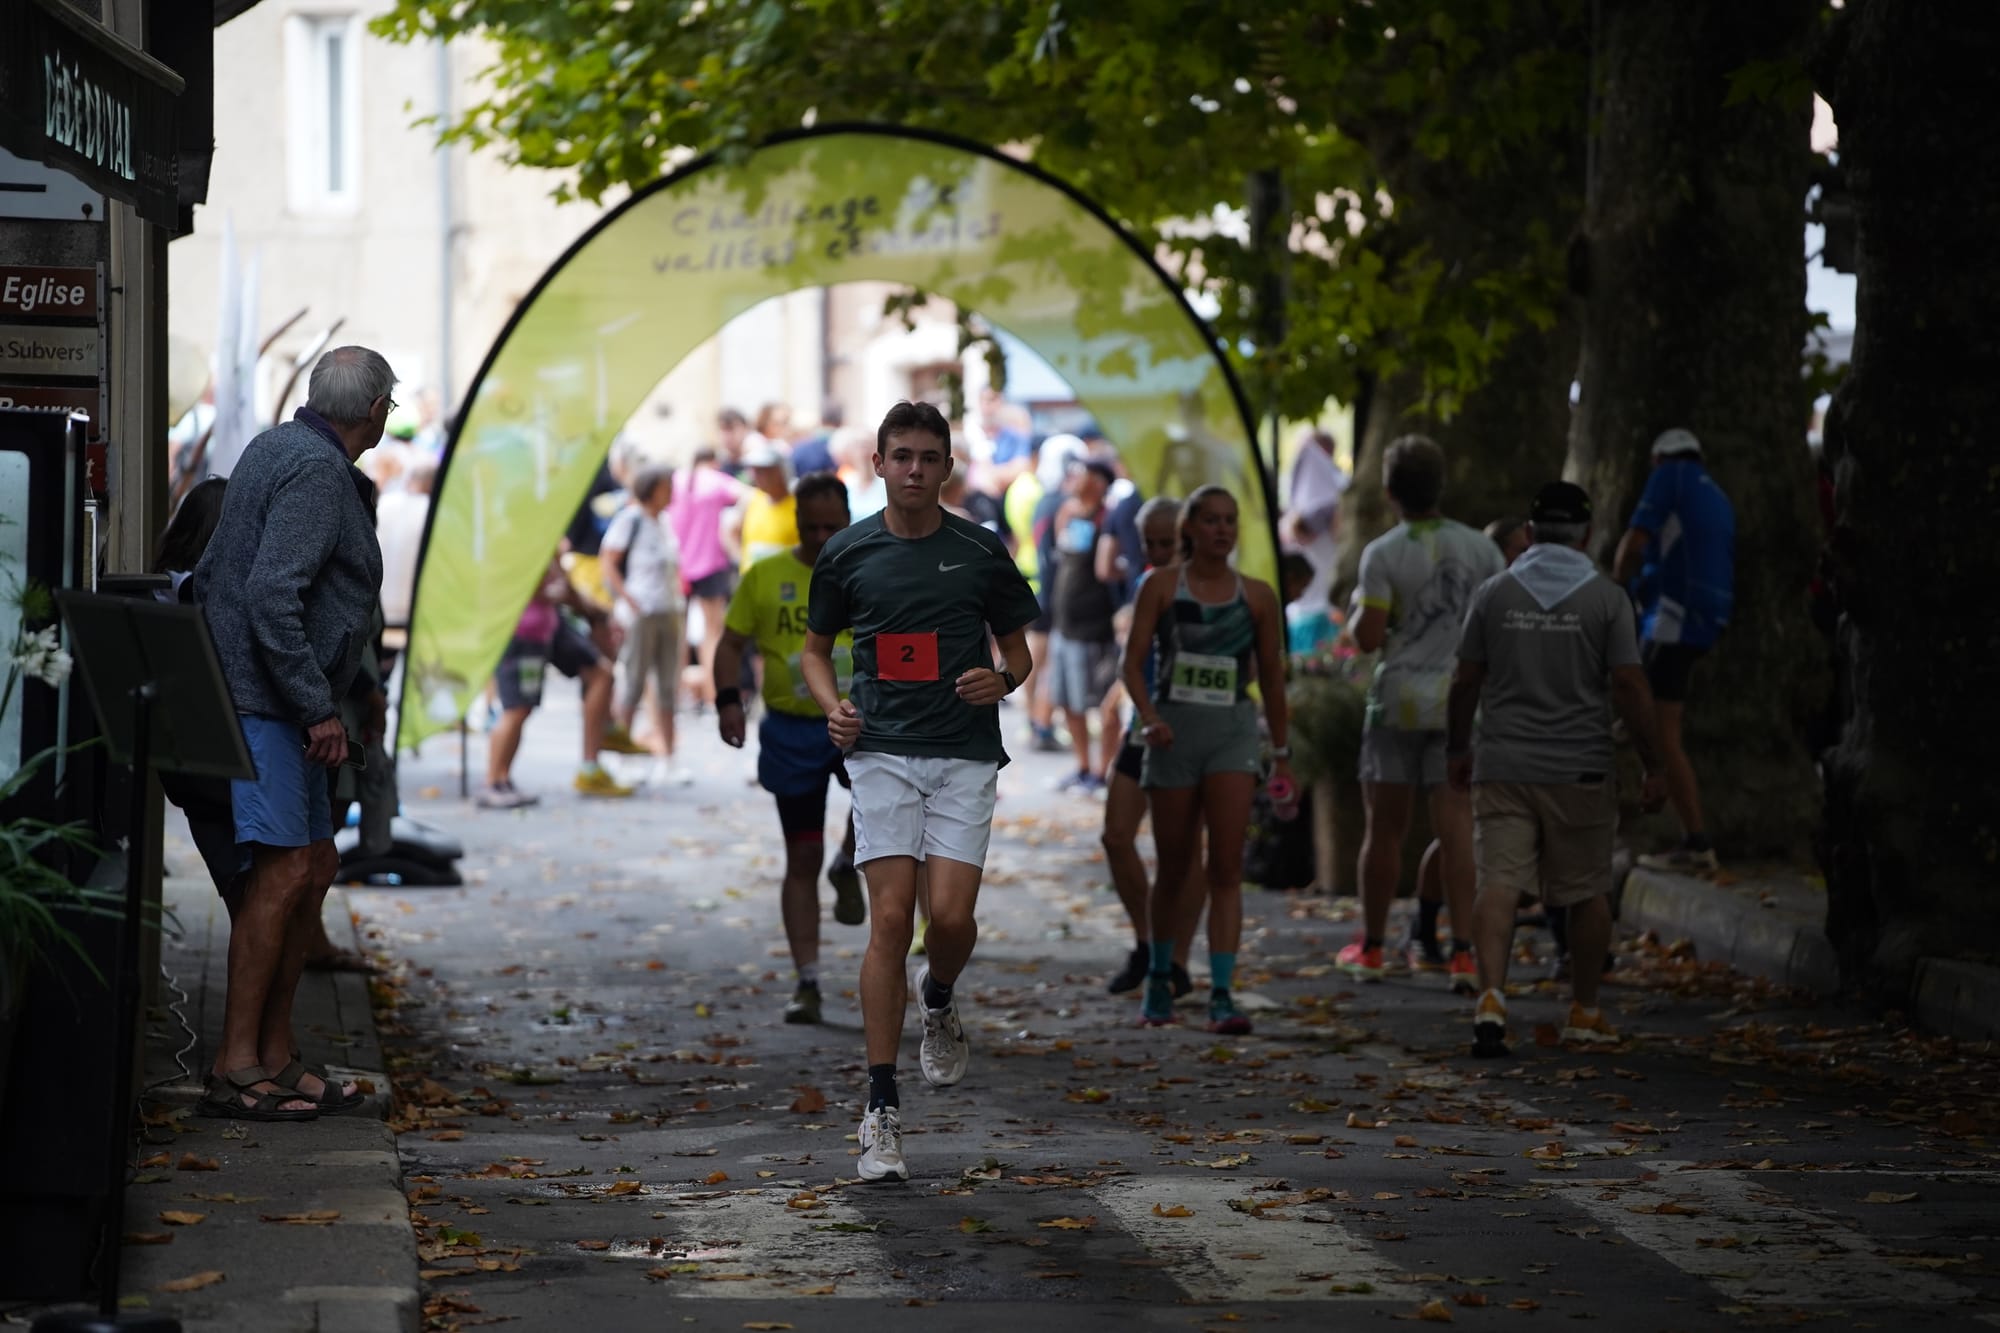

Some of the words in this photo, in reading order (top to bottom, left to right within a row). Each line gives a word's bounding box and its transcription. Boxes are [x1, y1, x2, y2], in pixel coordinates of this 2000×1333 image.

[671, 193, 881, 237] Challenge
[3, 276, 86, 312] Eglise
[900, 645, 915, 663] 2
[1184, 665, 1229, 689] 156
